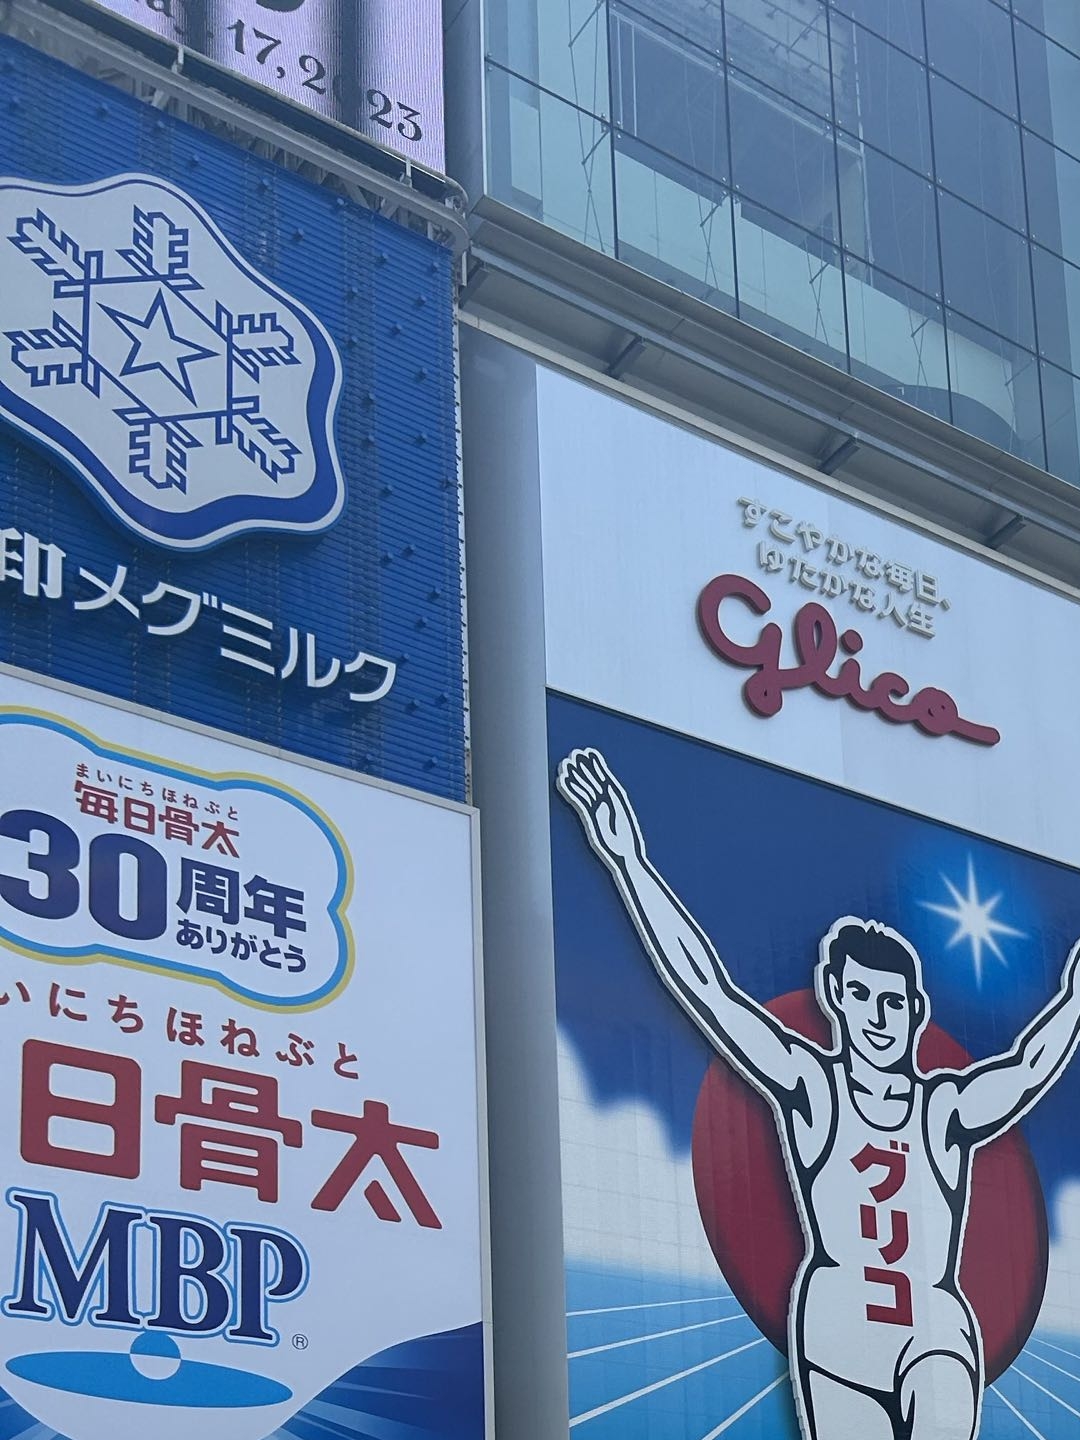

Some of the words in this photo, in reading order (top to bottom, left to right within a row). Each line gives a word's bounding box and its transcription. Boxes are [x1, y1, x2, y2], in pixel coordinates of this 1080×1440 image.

[0, 527, 397, 702] 印メグミルク
[697, 574, 1000, 747] Glico
[759, 541, 936, 640] ゆたかな人生
[74, 780, 241, 859] 毎日骨太
[75, 763, 240, 822] まいにちほねぶと
[0, 809, 308, 941] 30周年
[176, 919, 307, 973] ありがとう
[20, 1039, 443, 1230] 日骨太
[4, 1190, 308, 1345] MBP
[850, 1139, 914, 1327] グリコ
